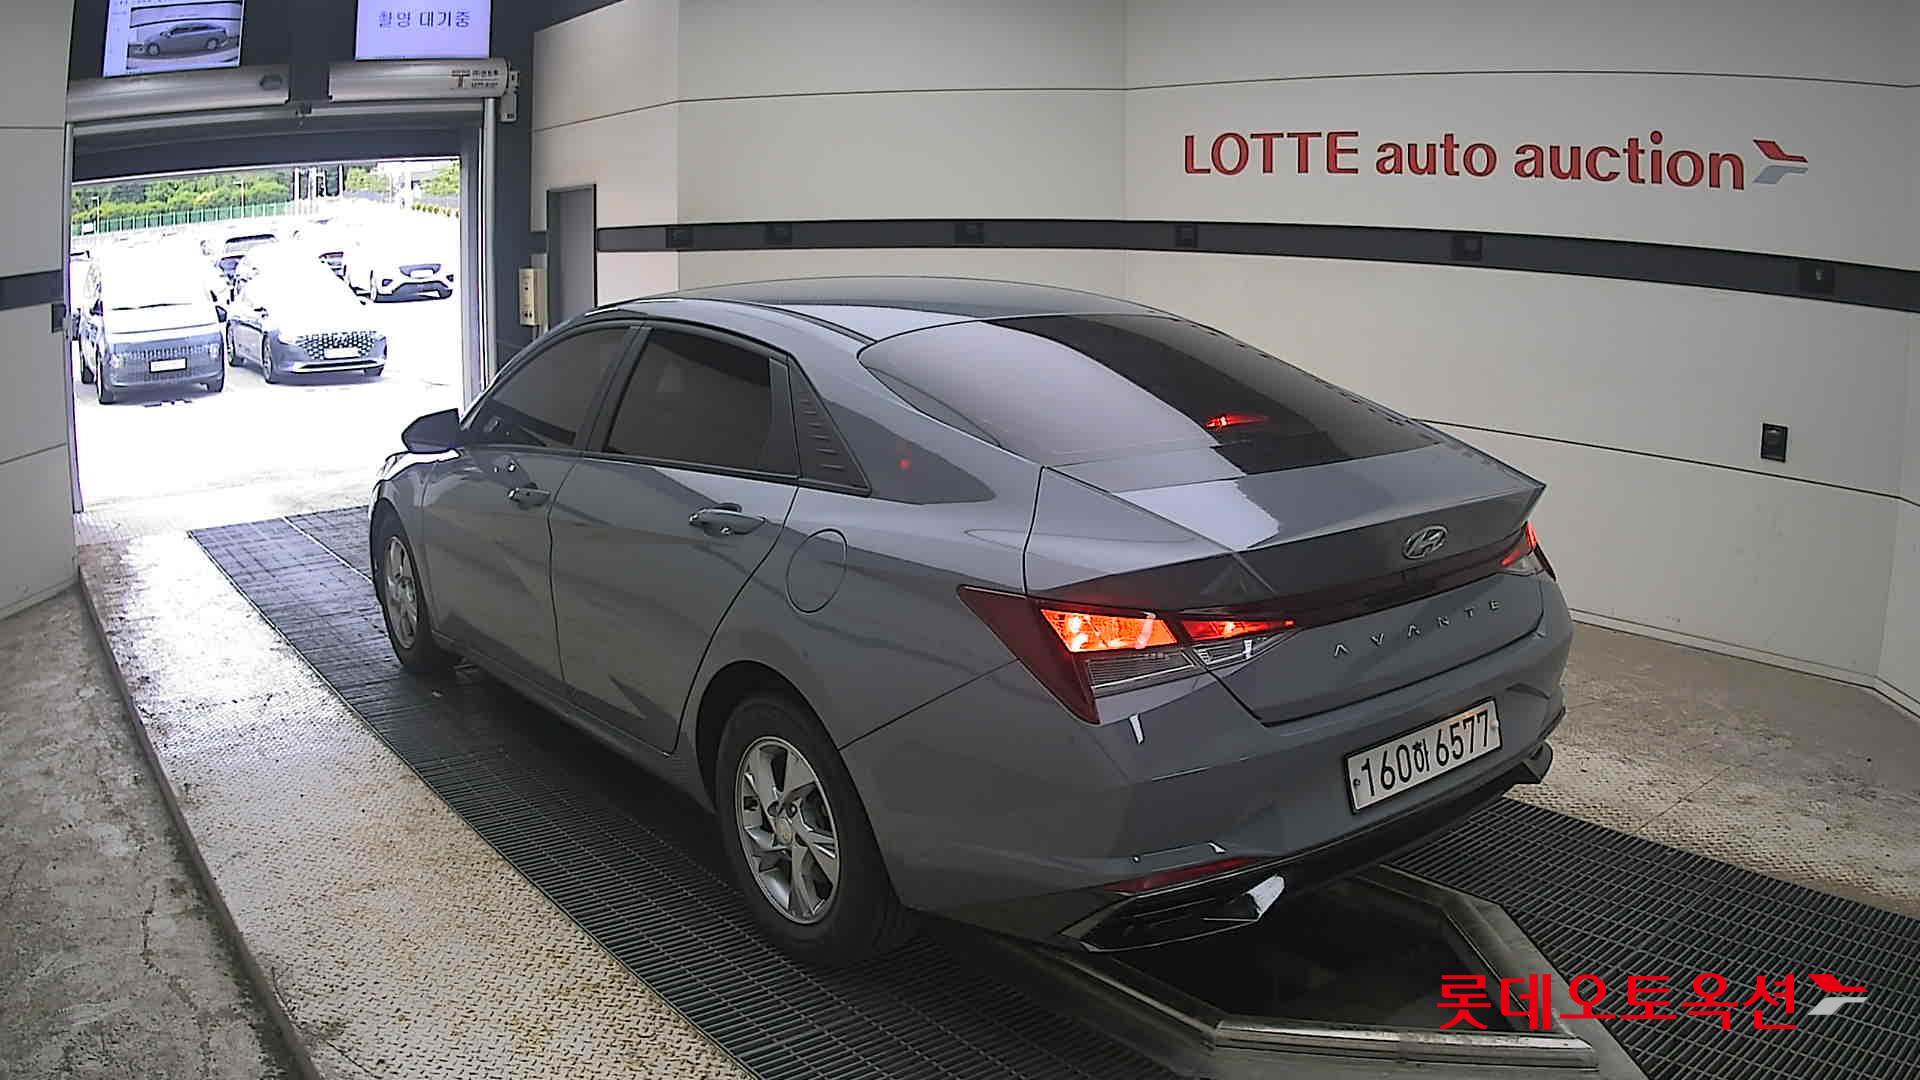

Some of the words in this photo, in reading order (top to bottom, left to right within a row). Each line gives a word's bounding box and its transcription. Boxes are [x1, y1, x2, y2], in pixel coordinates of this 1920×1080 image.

[419, 10, 471, 28] 대기중
[1184, 130, 1360, 175] LOTTE
[1375, 133, 1498, 177] auto
[1513, 130, 1746, 191] auction
[1333, 599, 1501, 658] AVANTE
[1435, 708, 1489, 767] 6577
